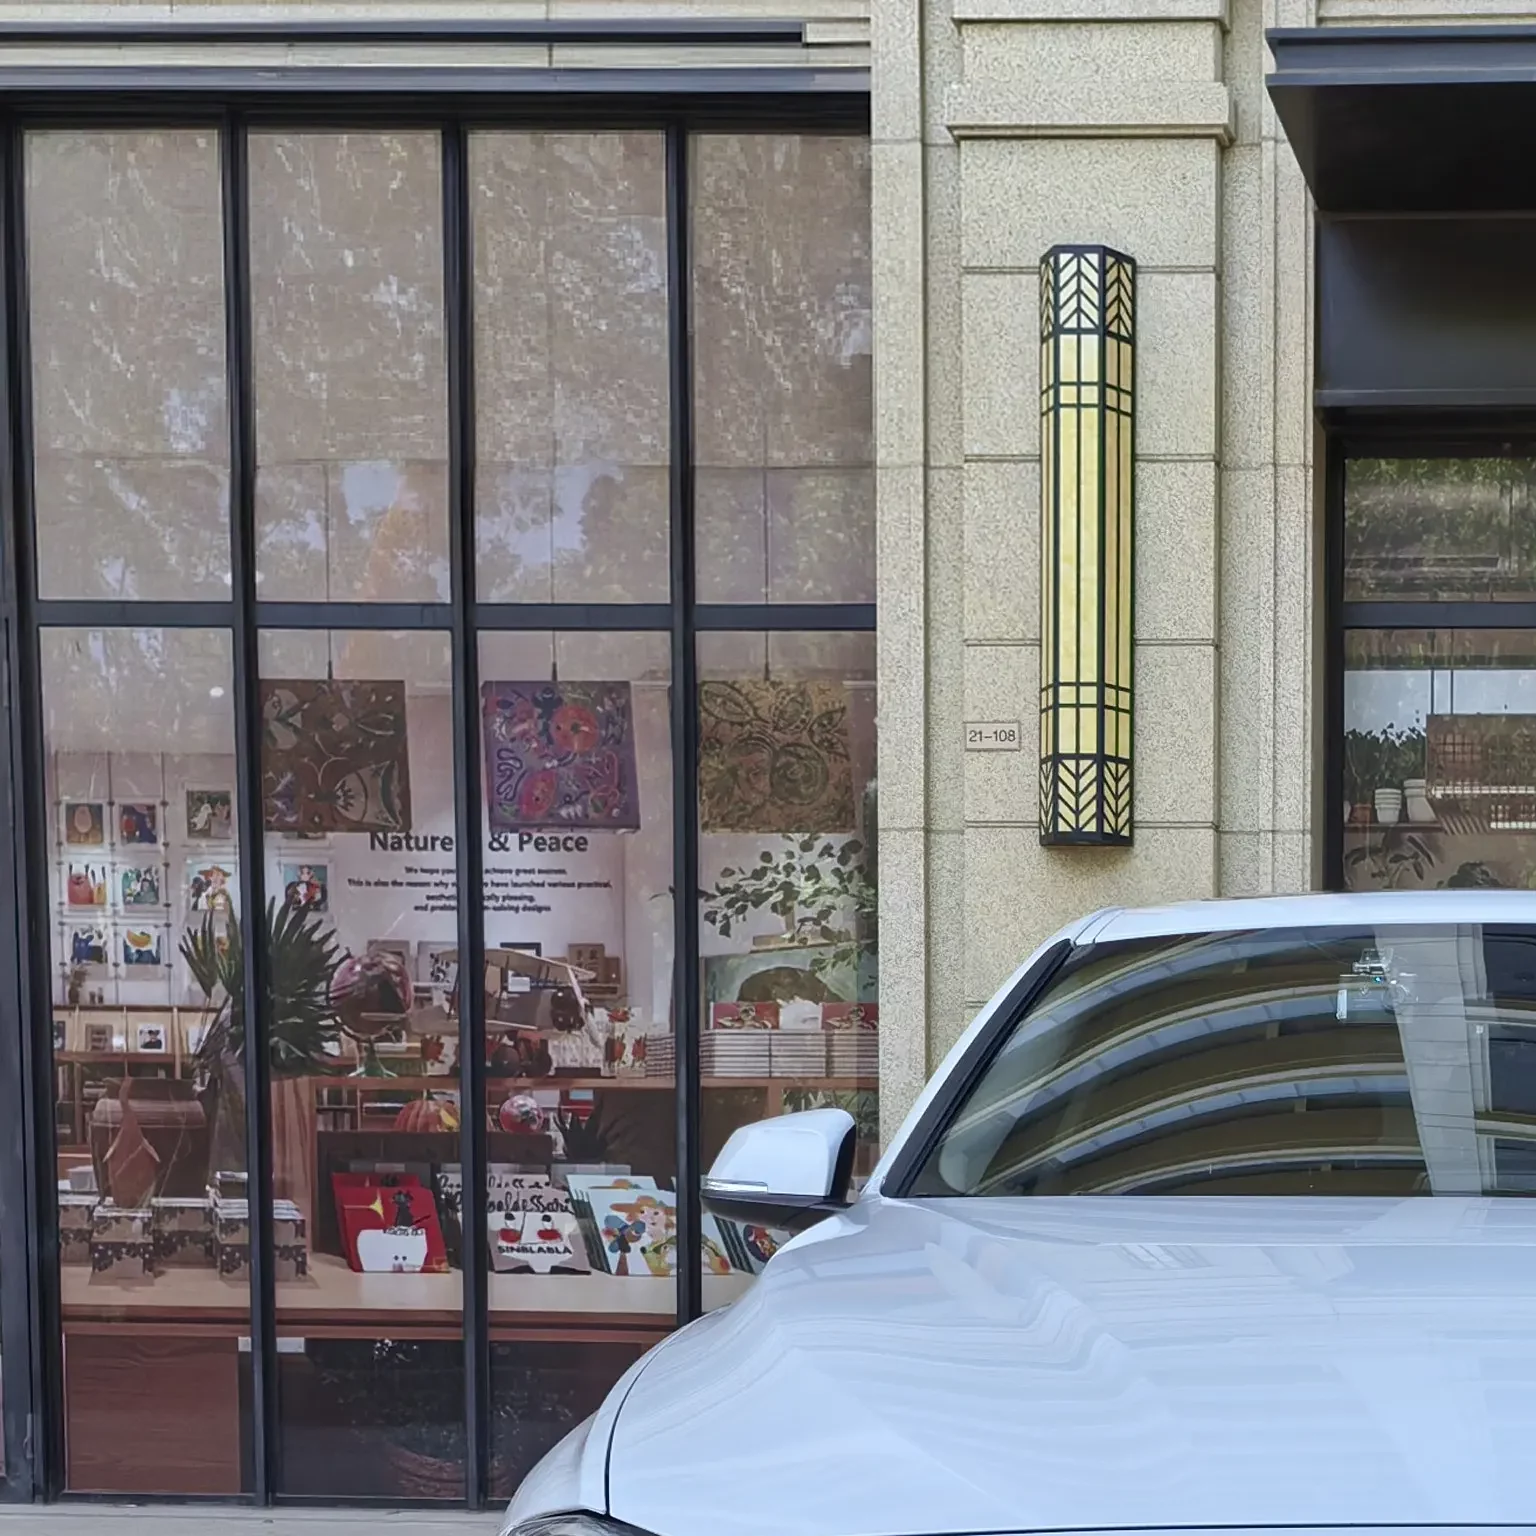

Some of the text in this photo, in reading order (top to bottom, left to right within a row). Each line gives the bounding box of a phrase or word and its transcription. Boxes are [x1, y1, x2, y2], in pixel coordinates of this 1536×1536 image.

[968, 729, 1016, 742] 21-108
[370, 832, 454, 852] Nature
[518, 832, 588, 852] Peace
